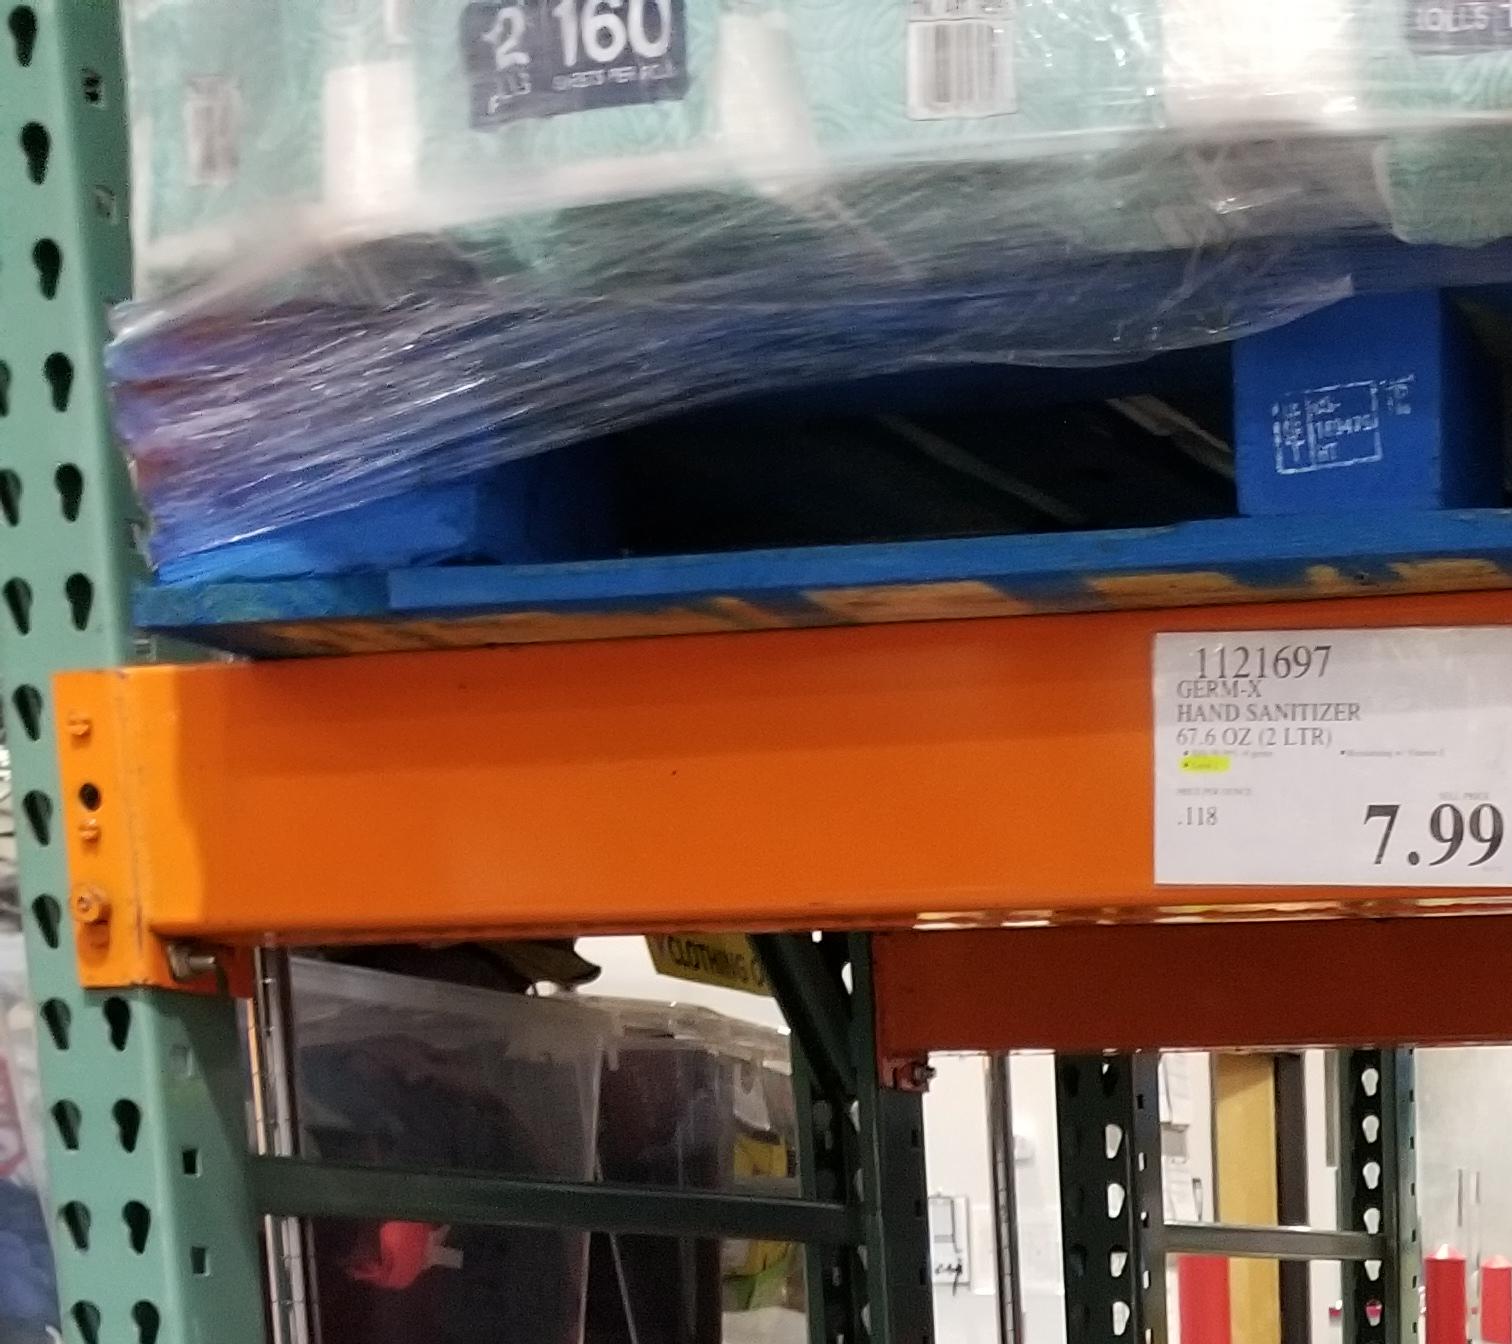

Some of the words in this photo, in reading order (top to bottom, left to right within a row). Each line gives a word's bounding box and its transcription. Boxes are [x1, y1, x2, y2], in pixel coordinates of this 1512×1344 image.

[552, 0, 672, 67] 160
[1195, 644, 1332, 680] 1121697
[1176, 679, 1263, 699] GERM-X
[1177, 703, 1240, 722] HAND
[1246, 702, 1361, 722] SANITIZER
[1176, 728, 1217, 746] 67.6
[1222, 728, 1251, 746] OZ
[1258, 727, 1277, 747] (2
[1284, 727, 1333, 747] LTR)
[1177, 806, 1219, 827] .118
[1363, 803, 1505, 867] 7.99
